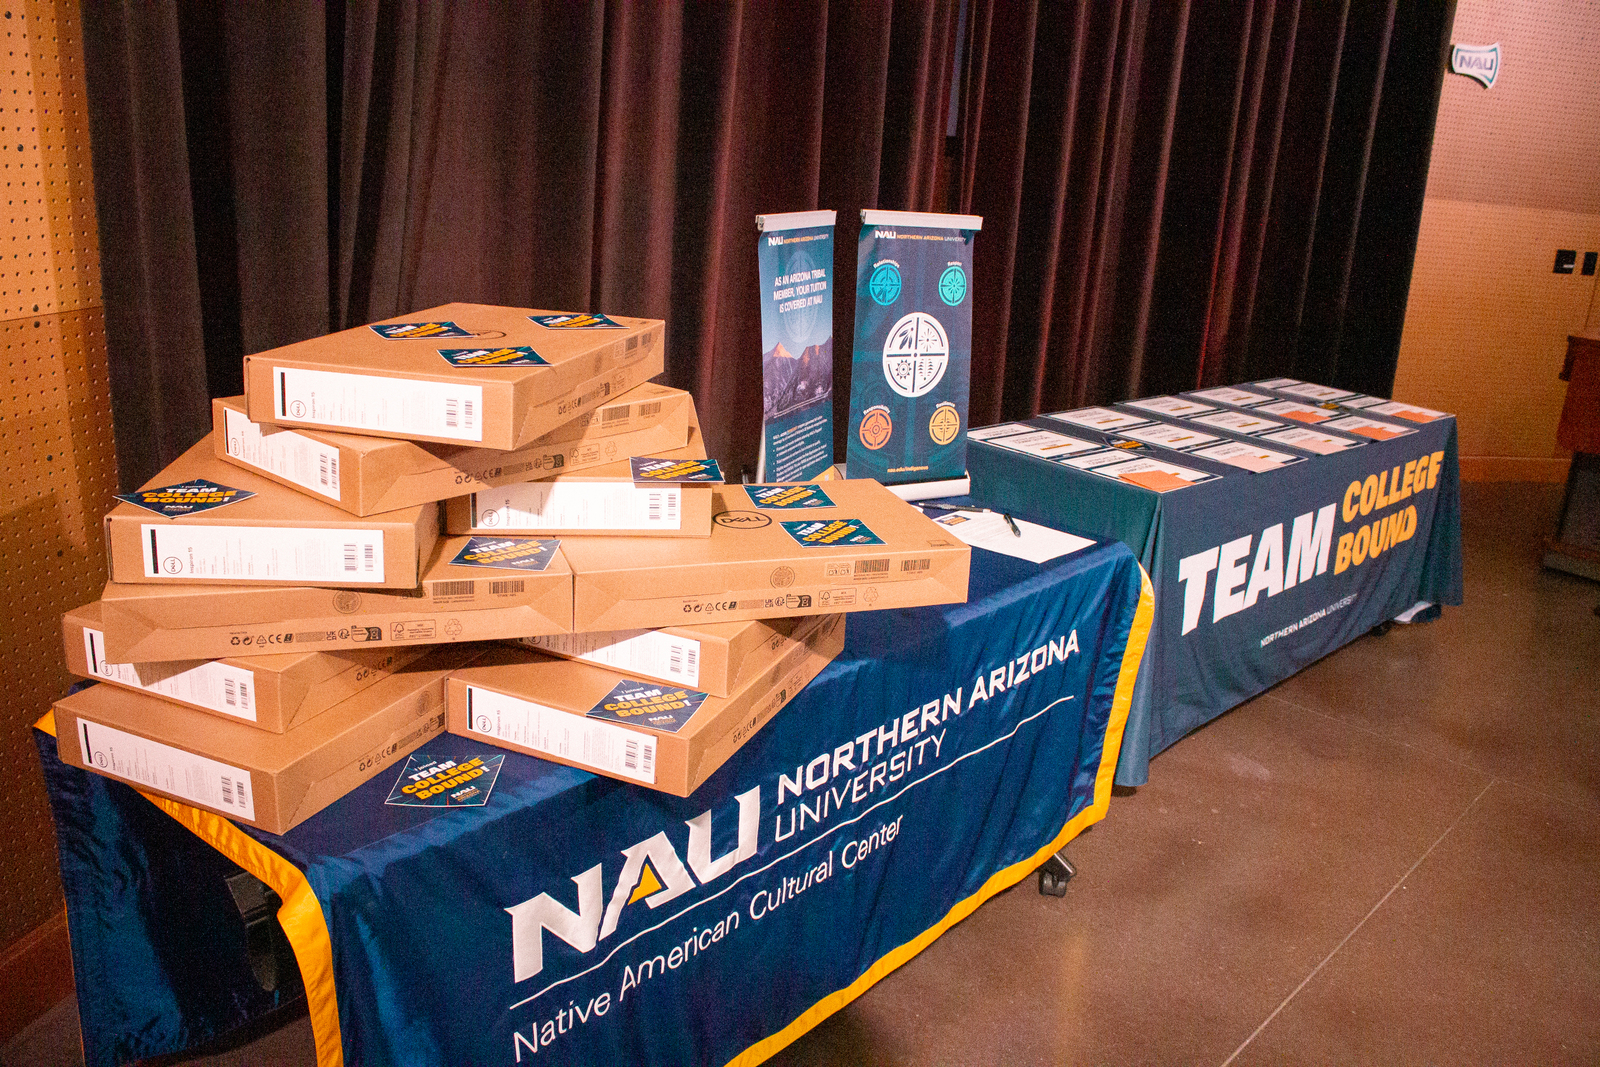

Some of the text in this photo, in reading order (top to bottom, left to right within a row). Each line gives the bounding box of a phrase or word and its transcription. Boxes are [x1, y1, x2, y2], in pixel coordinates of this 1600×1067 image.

[1459, 55, 1494, 70] NAU
[768, 236, 783, 246] NAU
[875, 230, 896, 239] NAU
[775, 269, 826, 286] AS AN ARIZONA TRIBAL
[774, 281, 826, 300] MEMBER, YOUR TUITION
[780, 295, 822, 313] IS COVERED AT NAU
[796, 522, 825, 536] TEAM
[802, 521, 848, 542] COLLEGE
[470, 541, 515, 553] TEAM
[1334, 505, 1418, 575] BOUND
[464, 541, 542, 560] COLLEGE
[1178, 502, 1337, 637] TEAM
[1261, 623, 1298, 648] NORTHERN
[1299, 609, 1326, 628] ARIZONA
[604, 691, 688, 711] COLLEGE
[614, 689, 662, 701] TEAM
[616, 700, 692, 717] BOUND!
[777, 629, 1080, 805] NORTHERN ARIZONA
[402, 757, 484, 794] COLLEGE
[408, 760, 457, 781] TEAM
[415, 765, 490, 800] BOUND!
[451, 785, 476, 798] NAU
[774, 728, 948, 844] UNIVERSITY
[504, 785, 761, 984] NAU
[513, 815, 904, 1063] Native American Cultural Center
